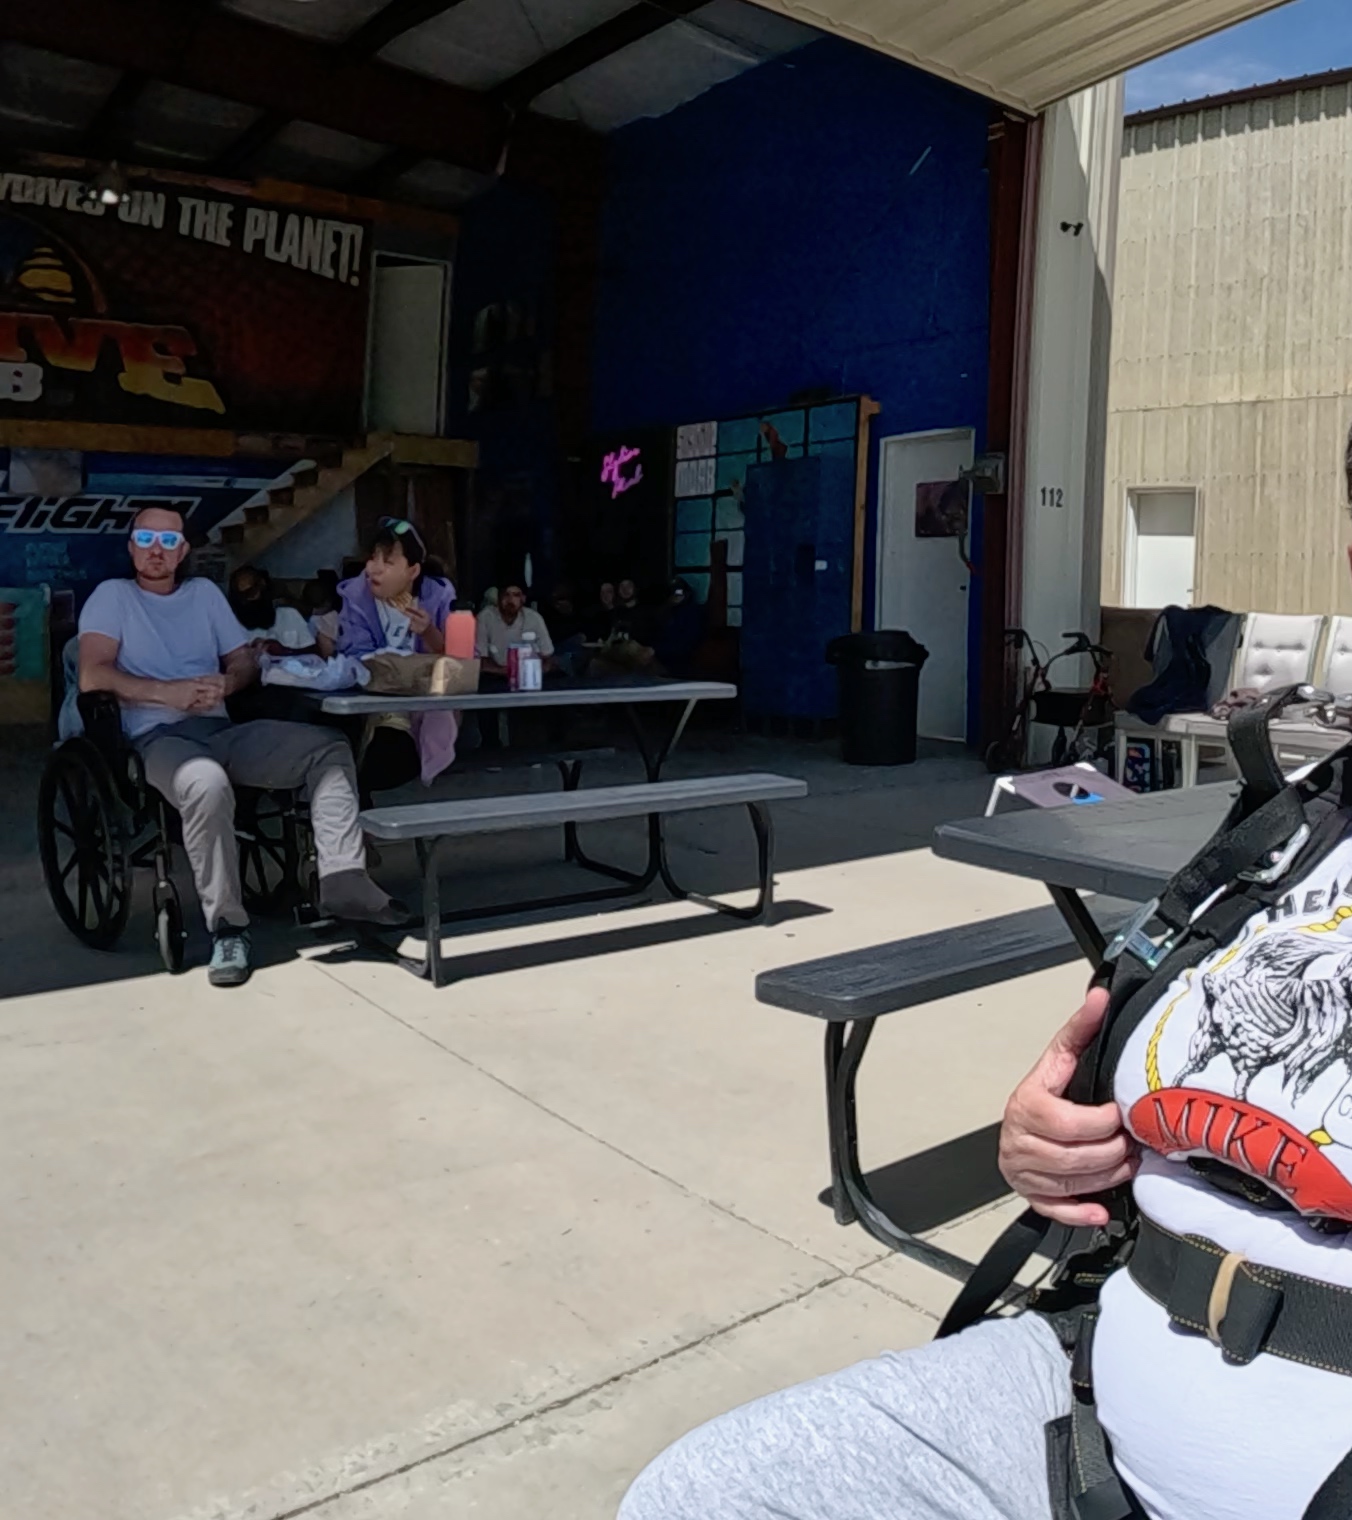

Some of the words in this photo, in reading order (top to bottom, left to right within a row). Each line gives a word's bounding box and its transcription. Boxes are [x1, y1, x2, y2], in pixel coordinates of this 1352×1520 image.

[117, 190, 167, 230] ON
[177, 196, 235, 248] THE
[242, 207, 364, 287] PLANET!
[1040, 486, 1064, 508] 112
[1152, 1097, 1308, 1195] MIKE
